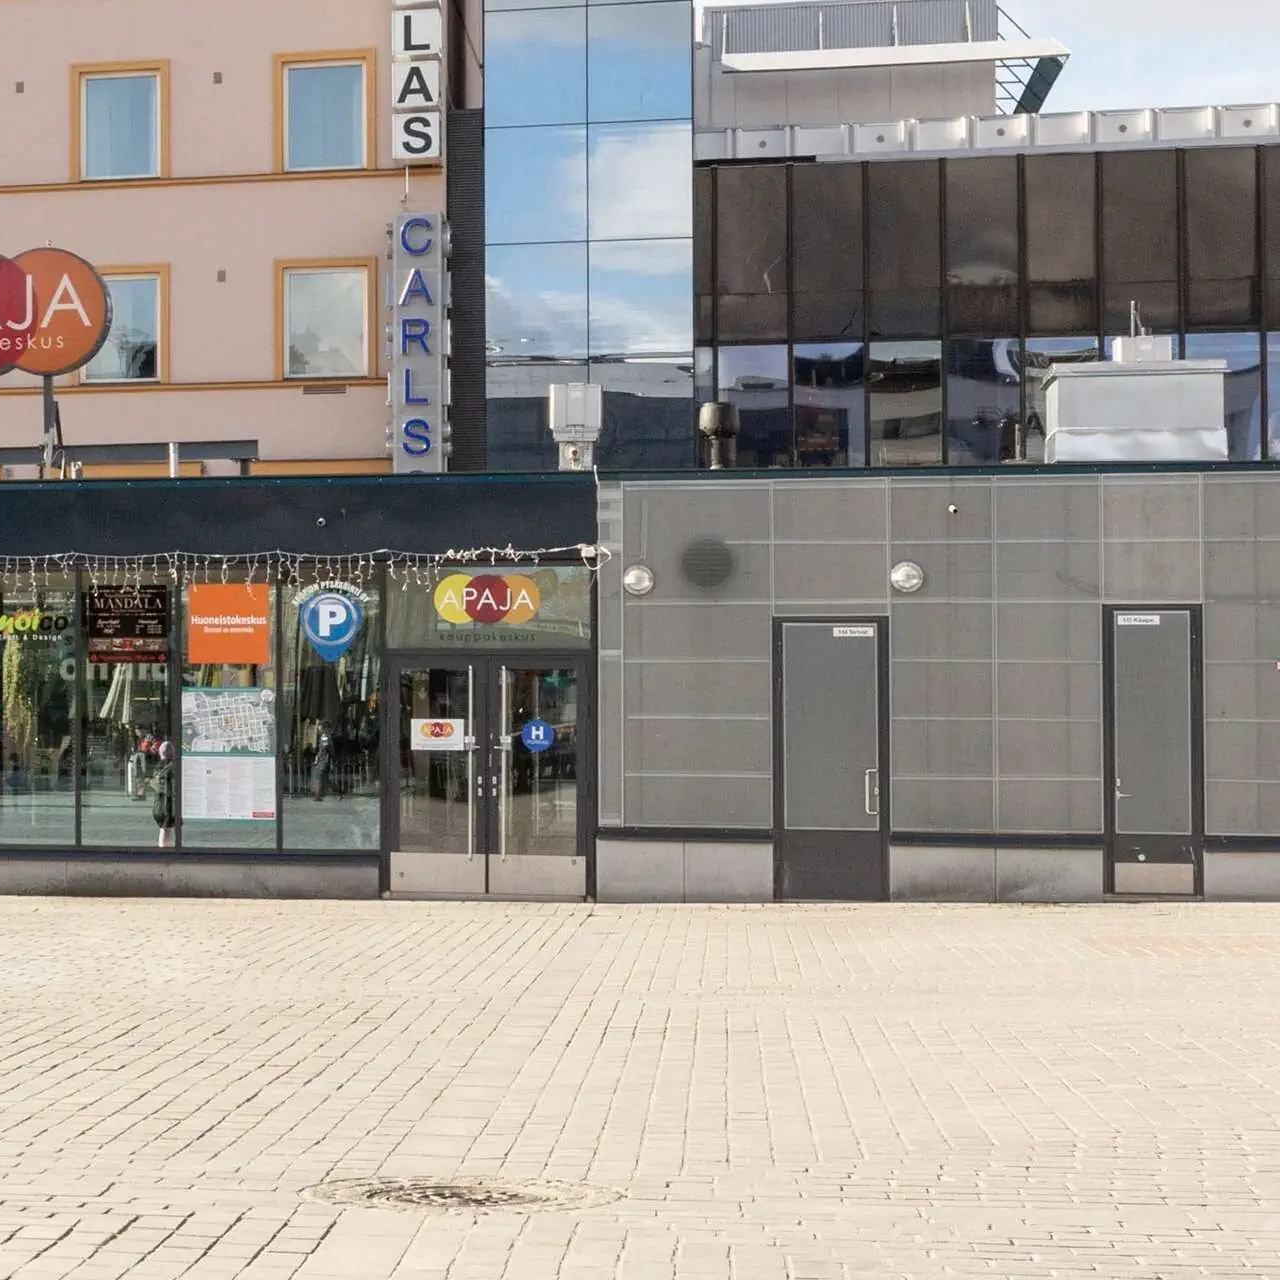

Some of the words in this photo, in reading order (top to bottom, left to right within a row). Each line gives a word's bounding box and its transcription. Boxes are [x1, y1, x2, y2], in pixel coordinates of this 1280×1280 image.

[399, 217, 434, 472] CARLS
[94, 598, 162, 609] MANDALA
[439, 587, 535, 611] APAJA
[191, 615, 267, 625] Huoneistokeskus
[318, 604, 347, 637] P
[32, 634, 63, 642] Design
[439, 631, 537, 643] kauppakeskus
[532, 726, 544, 740] H
